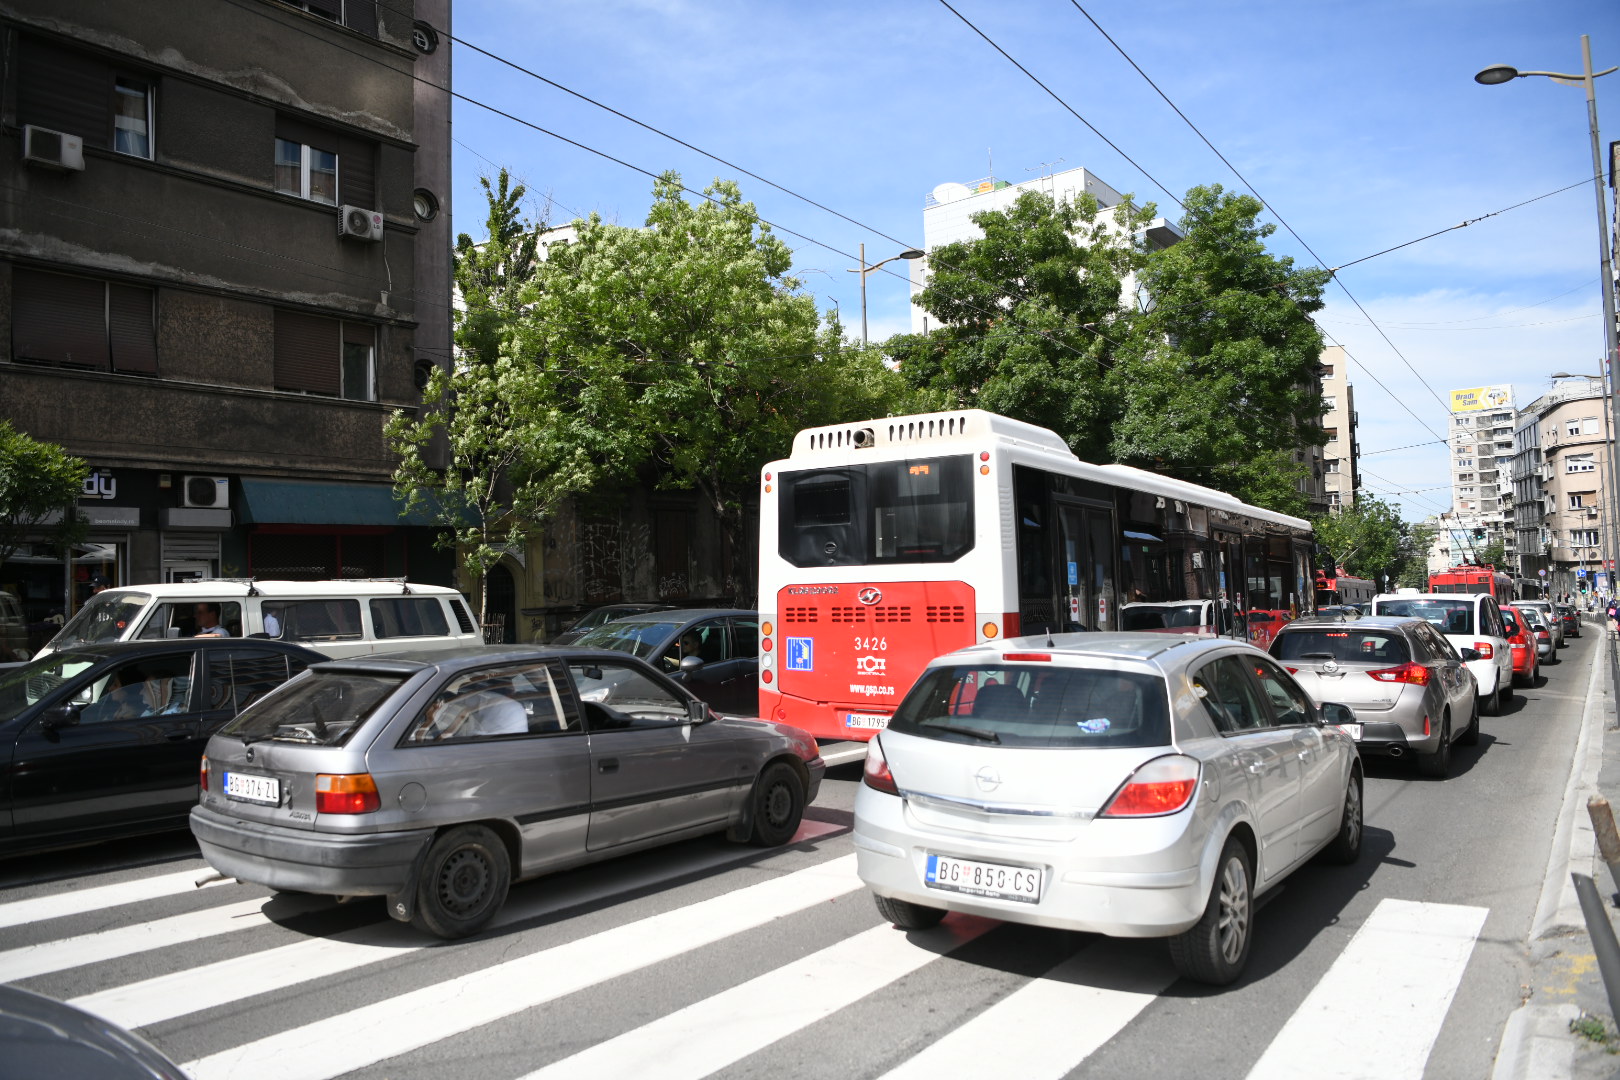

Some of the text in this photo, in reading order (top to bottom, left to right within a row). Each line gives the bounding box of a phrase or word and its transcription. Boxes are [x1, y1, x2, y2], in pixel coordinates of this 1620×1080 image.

[854, 636, 887, 651] 3426
[849, 684, 895, 697] www.gsp.co.rs
[852, 716, 861, 726] BG
[230, 776, 240, 792] BG
[939, 861, 960, 881] BG
